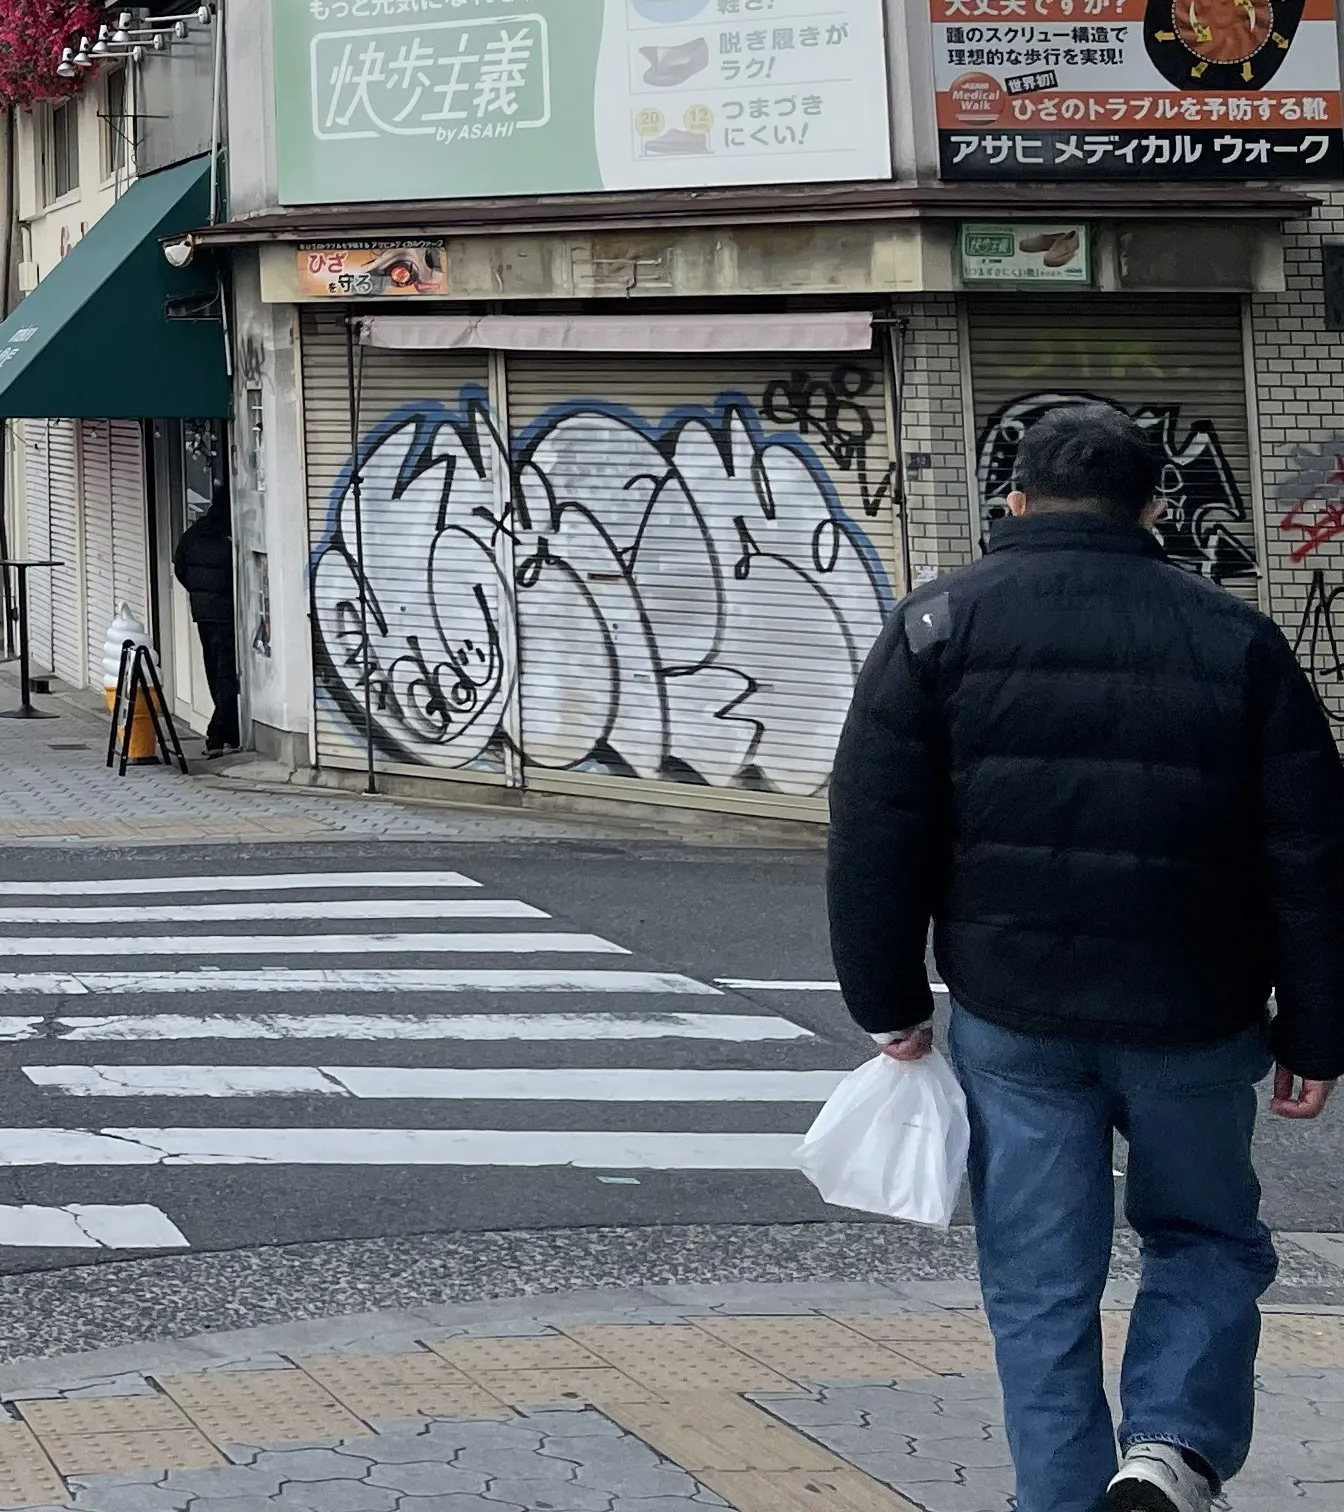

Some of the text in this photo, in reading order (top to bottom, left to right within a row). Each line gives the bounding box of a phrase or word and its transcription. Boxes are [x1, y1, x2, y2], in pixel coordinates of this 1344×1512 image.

[718, 22, 849, 55] 脱ぎ履きが
[720, 56, 776, 81] ラク!
[947, 47, 1124, 67] 理想的な歩行を実現!
[325, 28, 534, 127] 快歩主義
[1008, 72, 1055, 93] 世界初!
[952, 89, 1000, 101] Medical
[961, 100, 992, 111] Walk
[640, 111, 660, 124] 20
[690, 108, 709, 122] 12
[721, 94, 824, 121] つまづき
[1012, 97, 1329, 123] ひざのトラブルを予防する靴
[435, 121, 515, 144] by ASAHI
[723, 122, 809, 148] にくい!
[949, 134, 1330, 165] アサヒ メディカル ウォーク
[307, 251, 349, 275] ひざ
[328, 273, 374, 295] を守る
